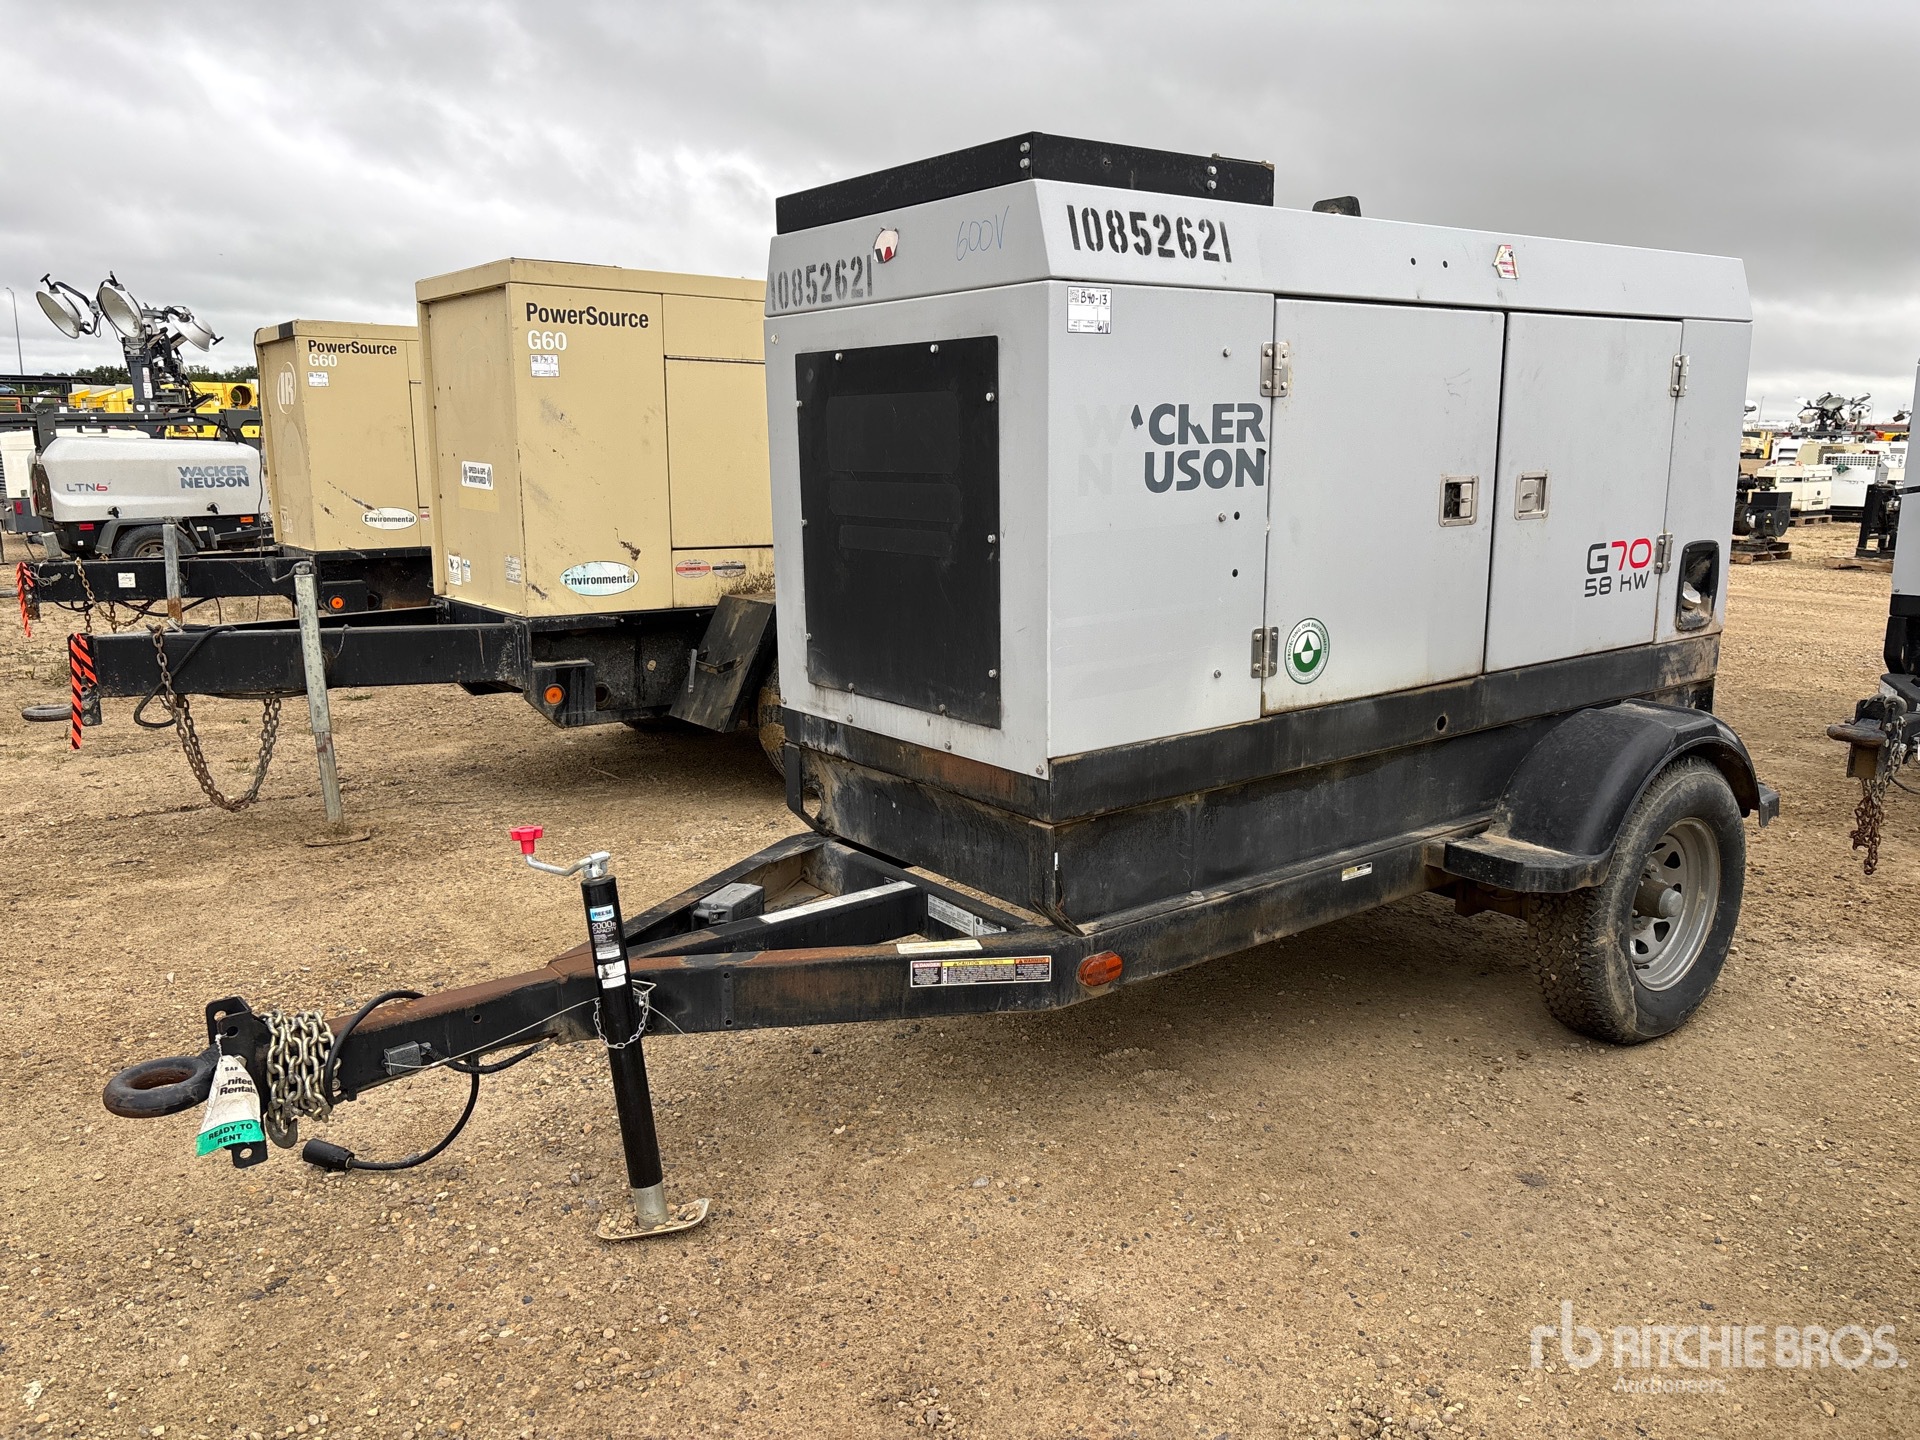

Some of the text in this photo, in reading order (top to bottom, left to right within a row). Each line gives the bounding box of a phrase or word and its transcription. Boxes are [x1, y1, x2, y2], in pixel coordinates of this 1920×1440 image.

[956, 206, 1010, 262] 600V
[1066, 204, 1232, 263] 10852621
[770, 254, 873, 312] 10852621
[526, 302, 649, 329] PowerSource
[527, 329, 568, 351] G60
[308, 340, 397, 355] PowerSource
[309, 353, 338, 367] G60
[178, 465, 248, 478] WACKER
[66, 483, 108, 492] LTN6
[181, 476, 251, 490] NEUSON
[364, 514, 415, 523] Environmental
[1586, 538, 1652, 575] G70
[564, 574, 636, 586] Environmental
[1584, 576, 1612, 598] 58
[592, 920, 612, 930] 2000
[593, 926, 617, 934] CAPACITY
[209, 1123, 253, 1141] READY TO
[217, 1133, 243, 1146] RENT
